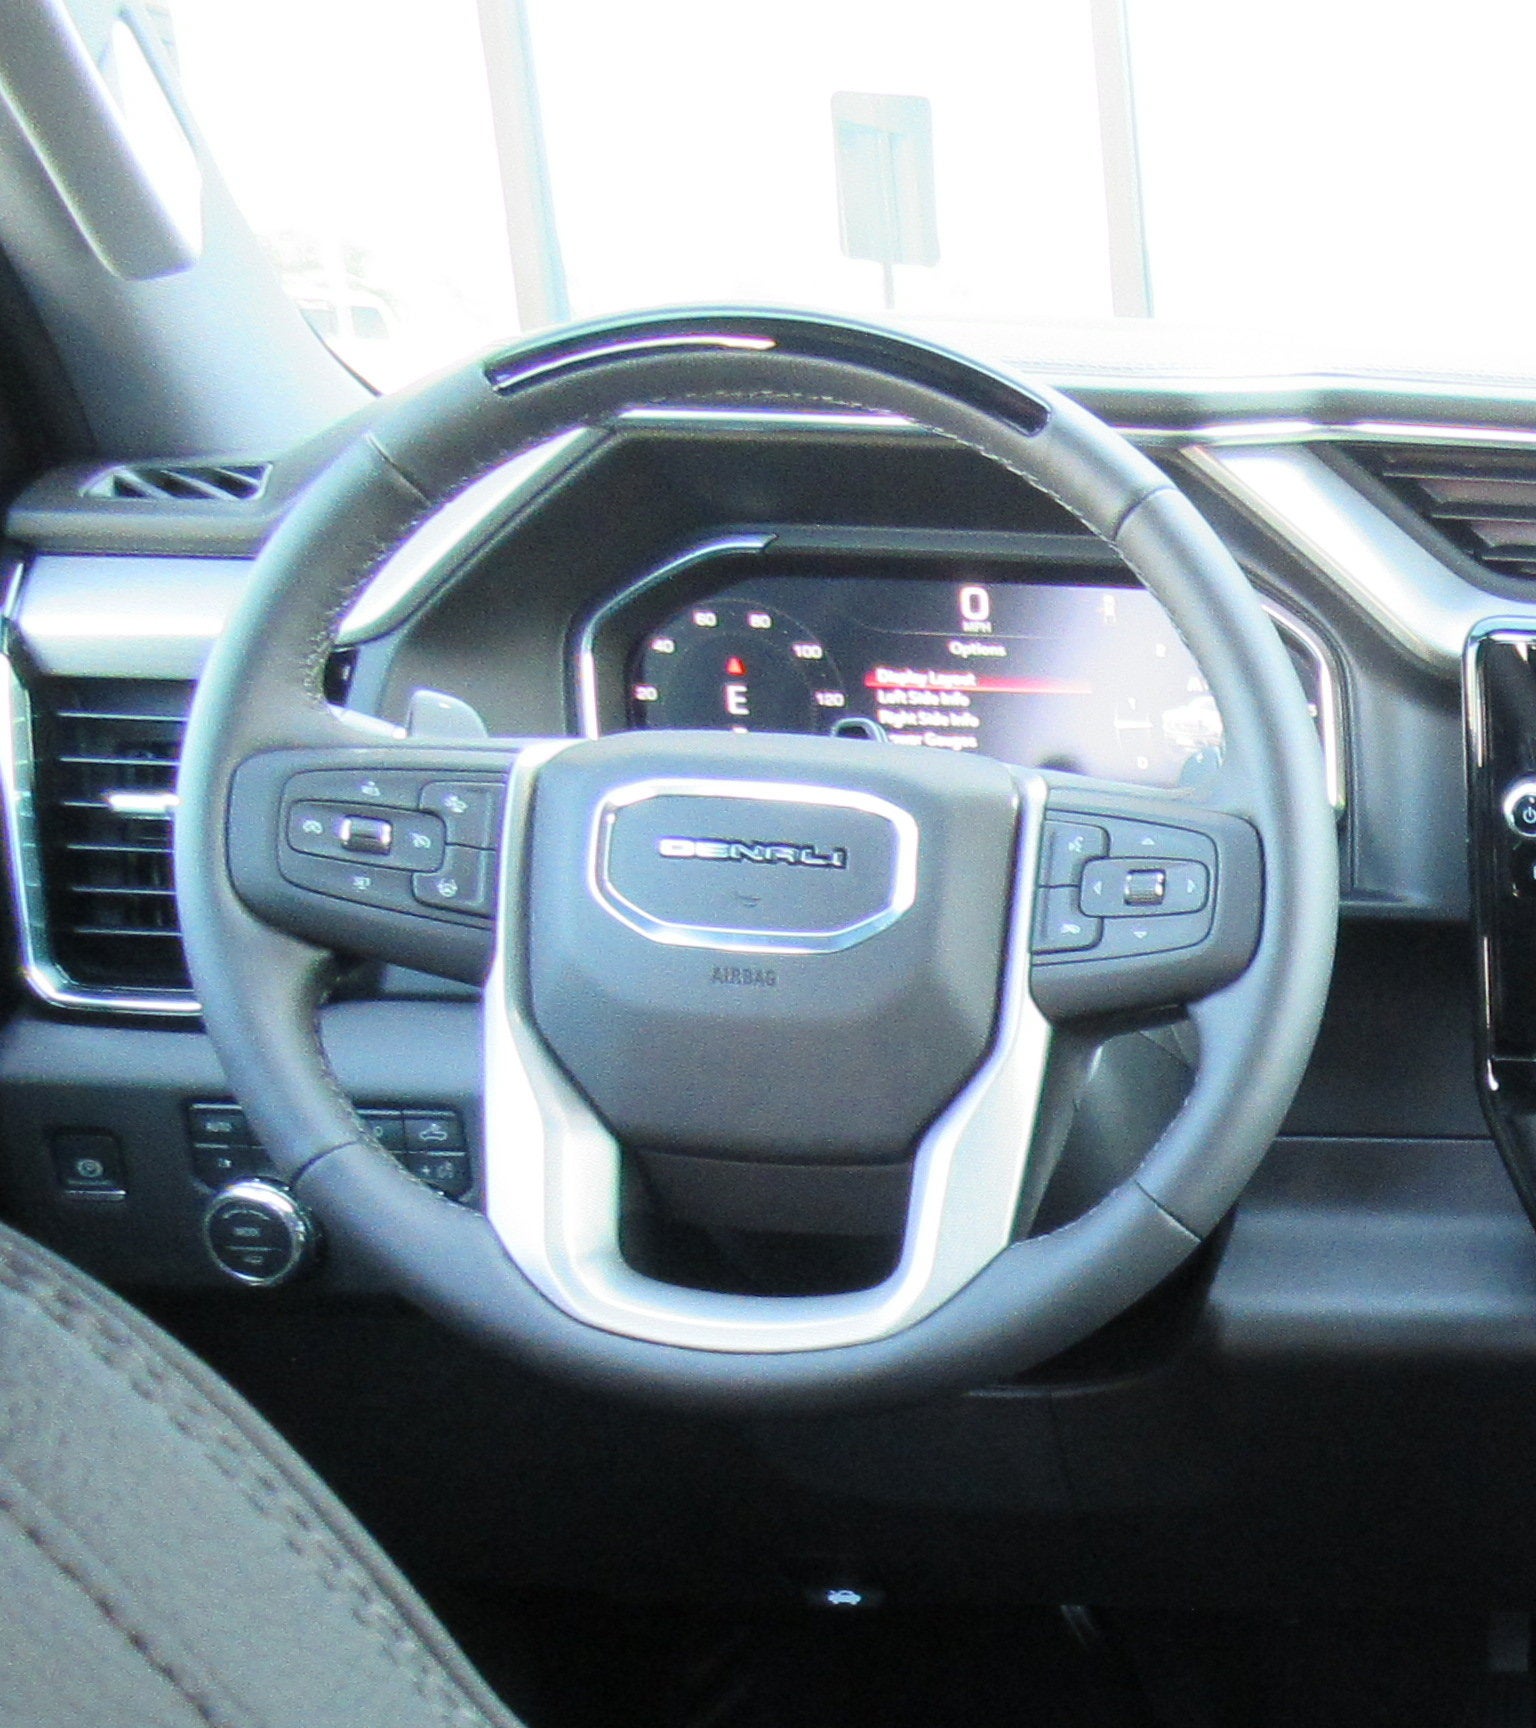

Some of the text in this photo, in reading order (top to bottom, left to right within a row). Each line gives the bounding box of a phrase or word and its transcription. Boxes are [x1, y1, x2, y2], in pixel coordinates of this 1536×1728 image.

[792, 643, 823, 660] 100
[948, 640, 1007, 658] Options
[815, 691, 845, 707] 120
[710, 965, 777, 987] AIRBAG
